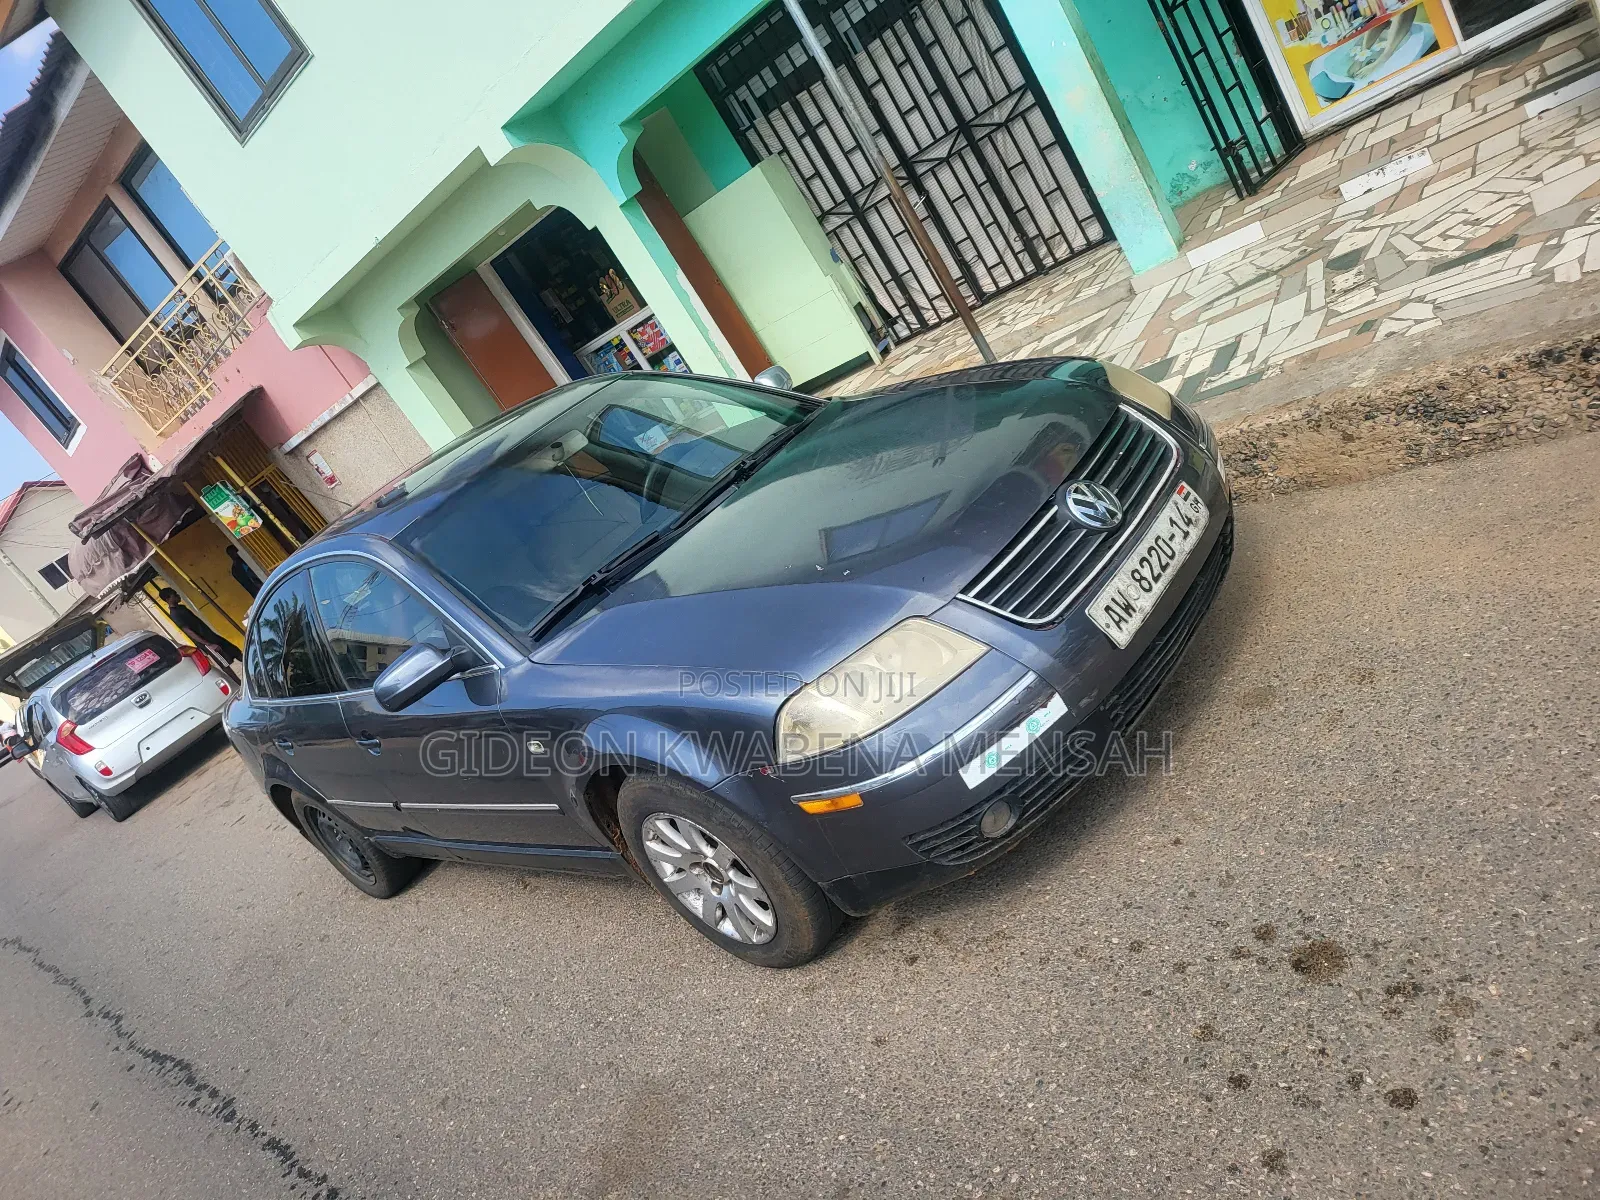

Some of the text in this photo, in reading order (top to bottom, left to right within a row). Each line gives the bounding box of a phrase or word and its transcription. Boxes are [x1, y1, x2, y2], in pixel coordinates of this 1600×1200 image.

[612, 299, 631, 313] ULTRA
[1190, 496, 1204, 514] GH
[1104, 504, 1194, 631] AW 8220-14
